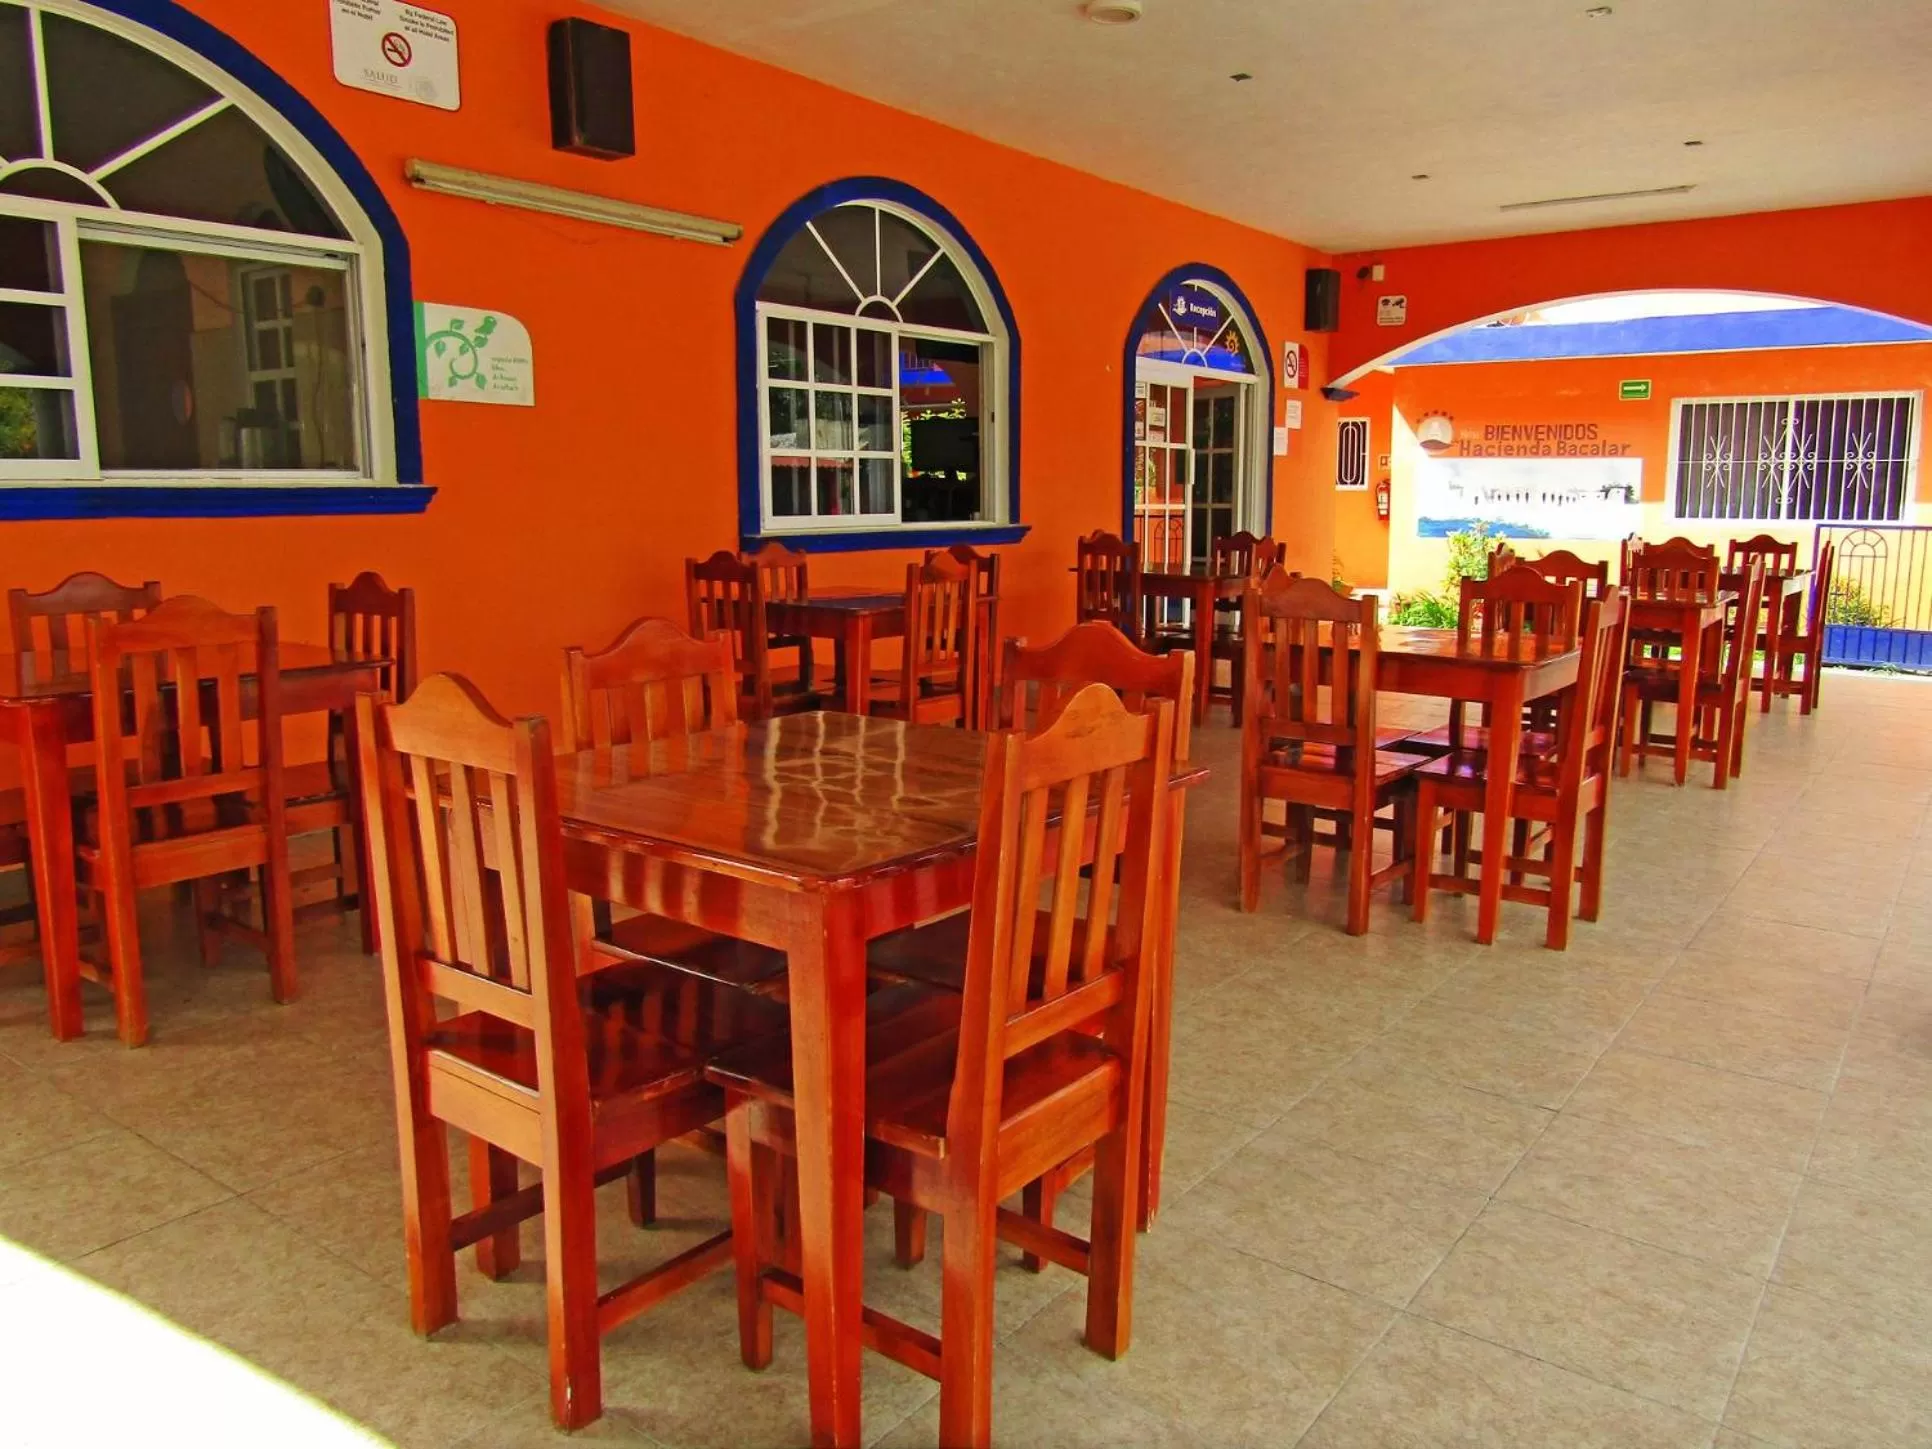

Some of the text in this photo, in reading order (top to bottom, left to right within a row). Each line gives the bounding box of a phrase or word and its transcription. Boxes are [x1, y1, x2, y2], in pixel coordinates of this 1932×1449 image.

[363, 68, 398, 83] SALUD
[1484, 424, 1598, 441] BIENVENIDOS
[1459, 440, 1631, 456] Hacienda Bacalar
